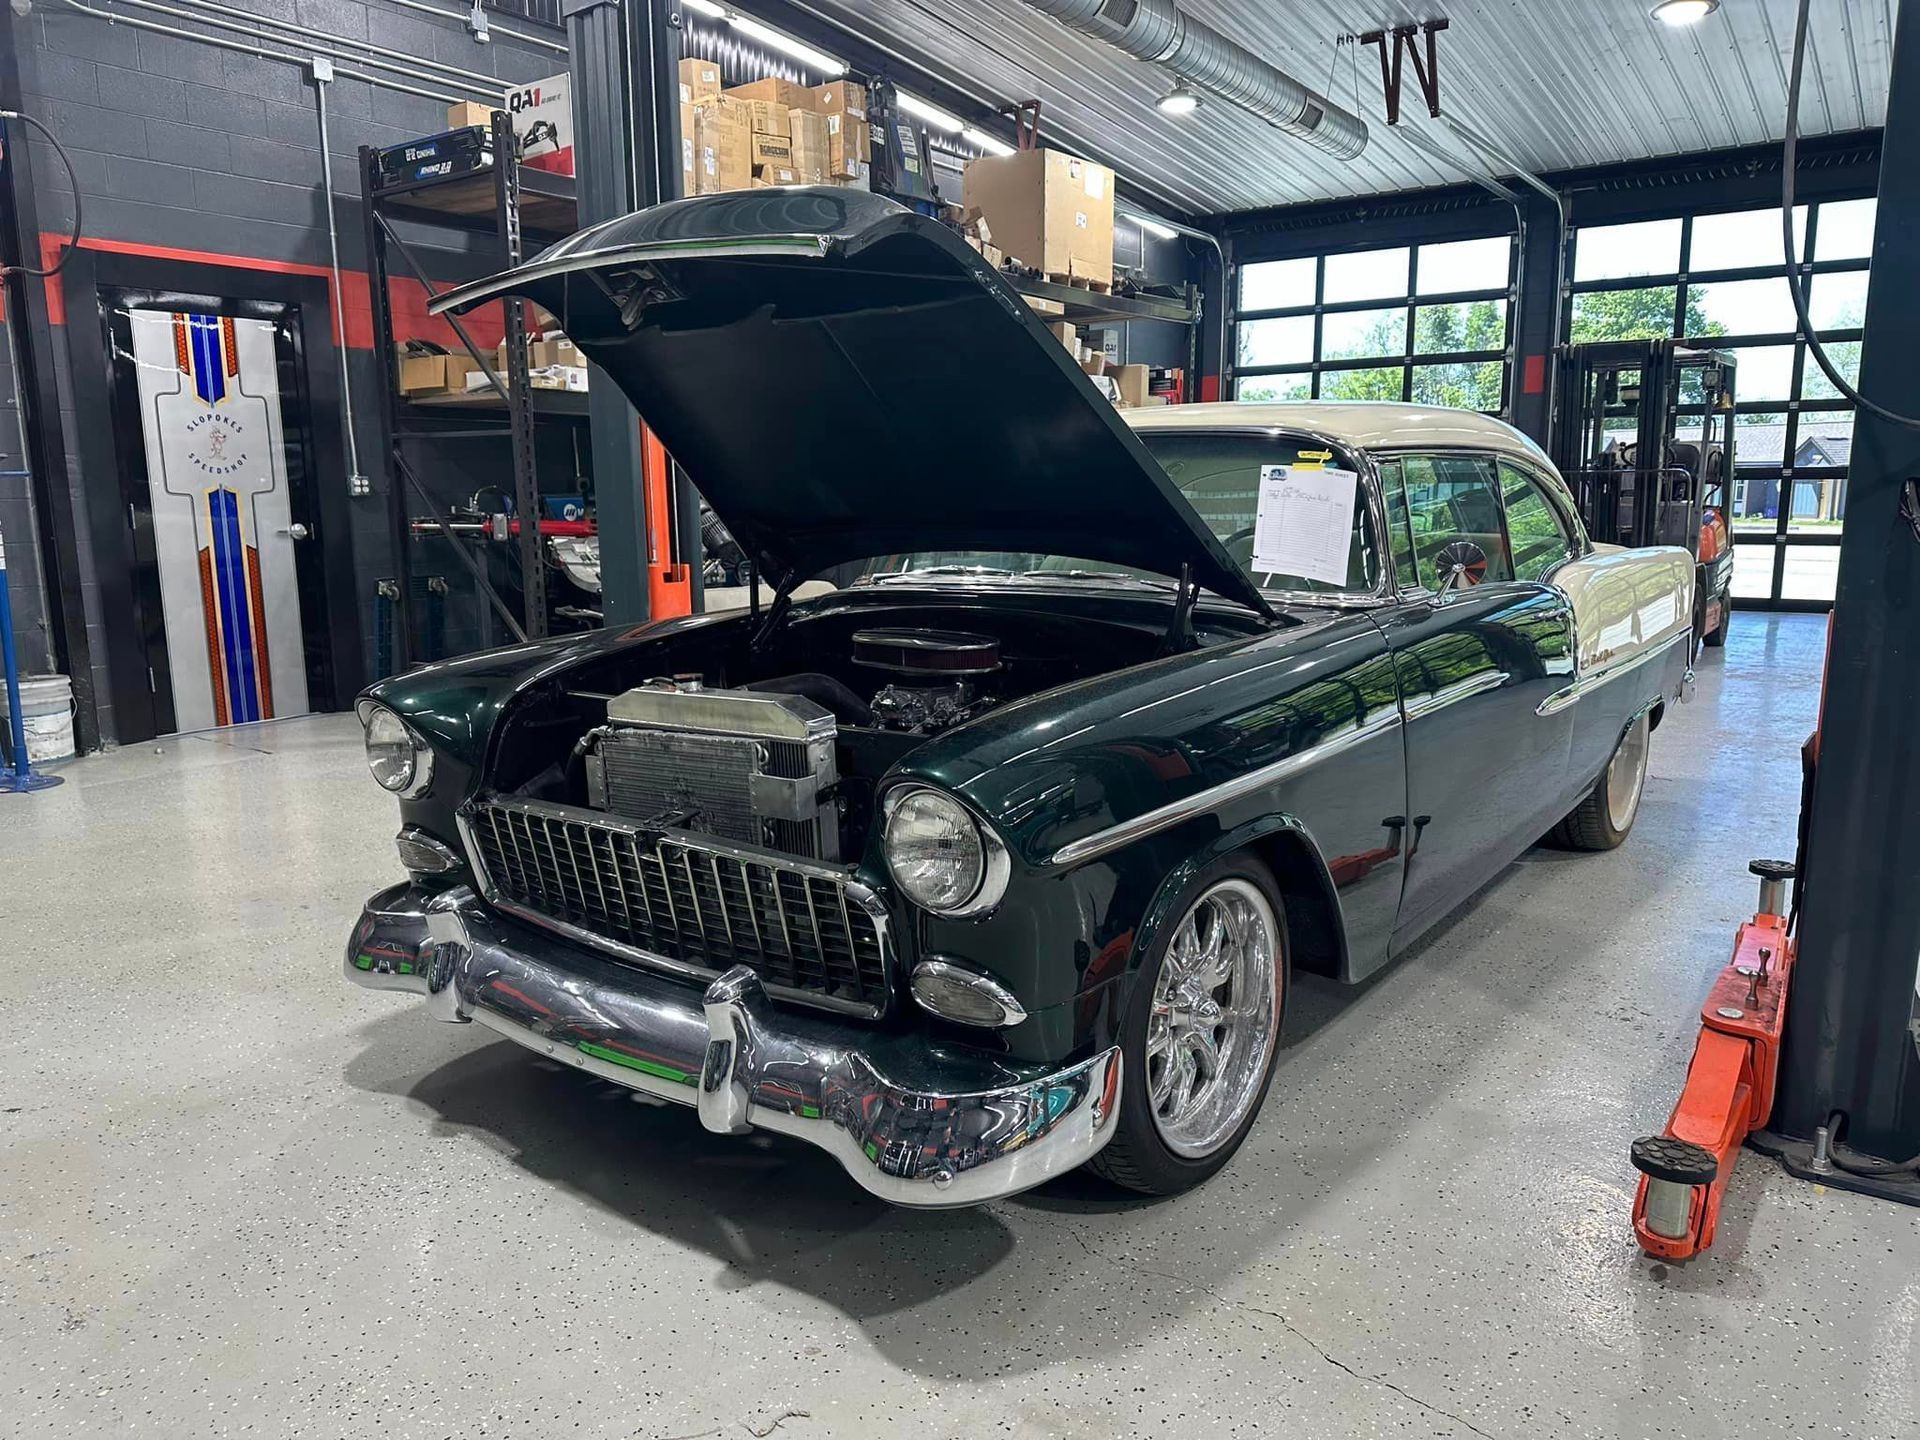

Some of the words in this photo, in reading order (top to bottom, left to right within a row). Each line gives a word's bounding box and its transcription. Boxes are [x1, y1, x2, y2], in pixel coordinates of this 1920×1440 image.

[510, 88, 541, 113] QA1
[187, 414, 242, 433] SLOPOKES
[188, 453, 247, 474] SPEEDSHOP
